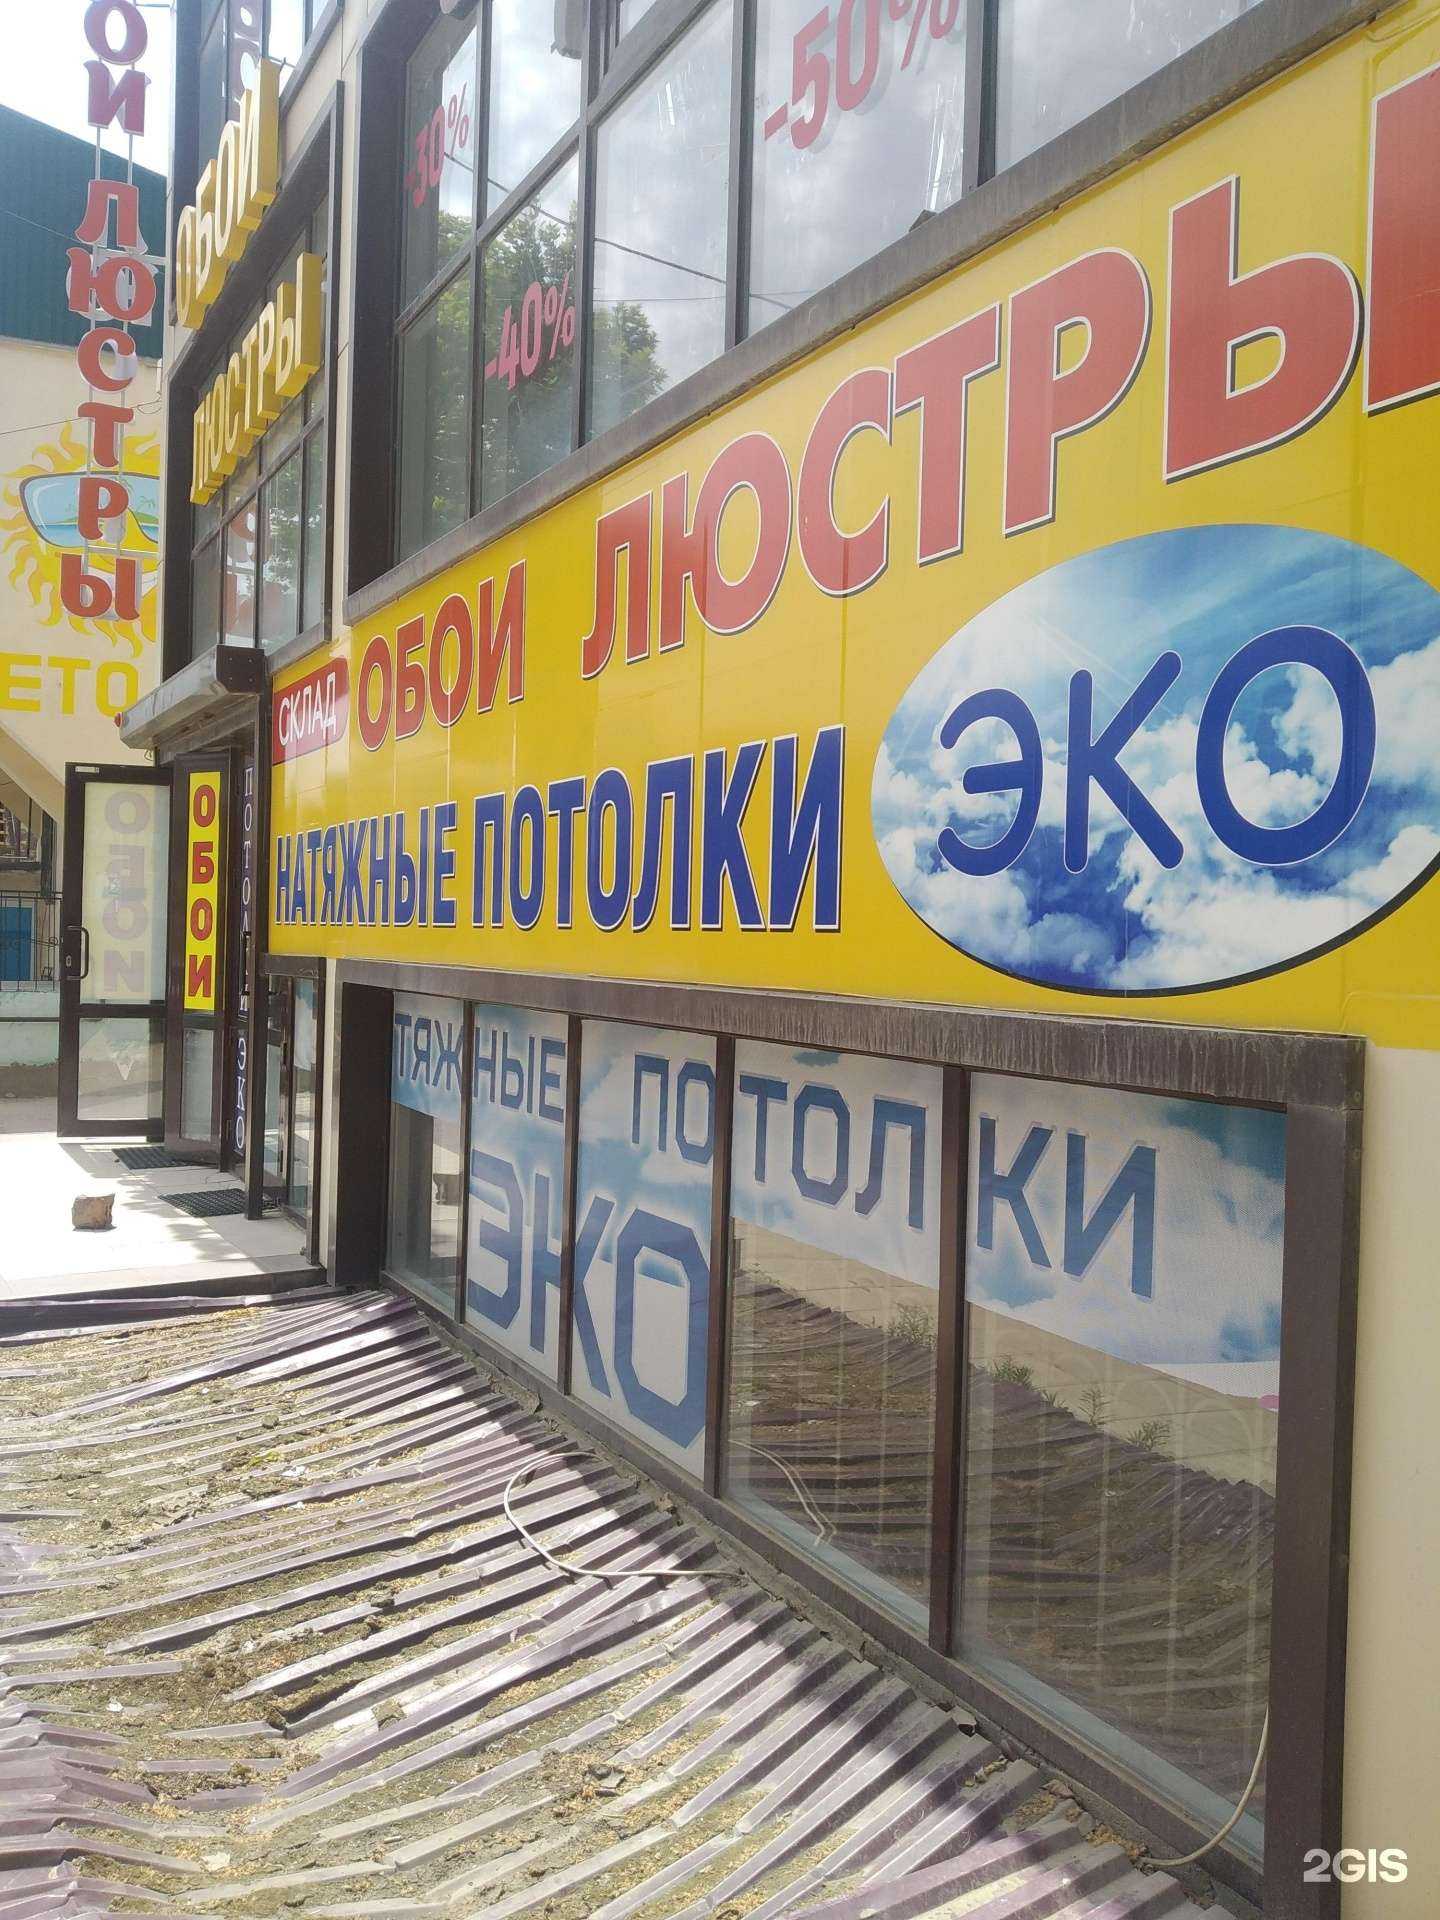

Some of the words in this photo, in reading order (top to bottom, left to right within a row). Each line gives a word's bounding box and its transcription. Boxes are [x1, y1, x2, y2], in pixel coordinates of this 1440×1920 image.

[176, 58, 280, 330] ОБОИ
[404, 82, 469, 208] -30%
[60, 179, 157, 621] ЛЮСТРЫ
[189, 252, 323, 505] ЛЮСТРЫ
[277, 672, 338, 746] СКЛАД
[357, 558, 529, 752] ОБОИ
[580, 60, 1440, 682] ЛЮСТРЫ
[484, 271, 575, 390] -40%
[274, 800, 459, 929] НАТЯЖНЫЕ
[472, 724, 846, 933] ПОТОЛКИ
[937, 624, 1377, 877] ЭКО
[188, 784, 216, 998] ОБОИ
[233, 1037, 247, 1149] ЭКО
[632, 1053, 1157, 1299] ПОТОЛКИ
[467, 1149, 711, 1449] ЭКО
